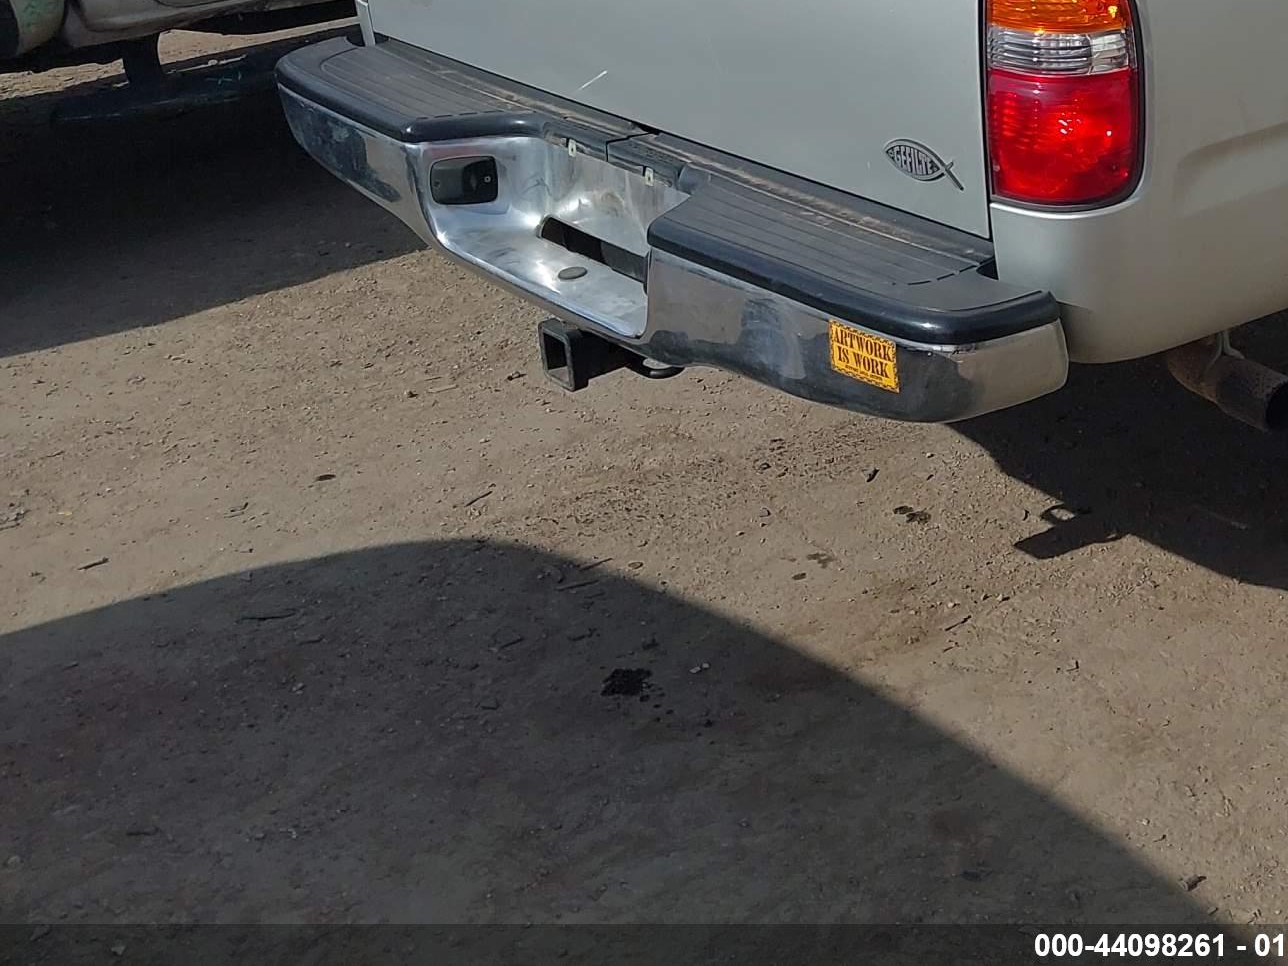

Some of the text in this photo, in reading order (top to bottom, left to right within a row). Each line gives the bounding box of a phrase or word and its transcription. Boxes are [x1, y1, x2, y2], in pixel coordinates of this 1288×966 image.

[893, 146, 934, 175] GEFILTE
[832, 327, 894, 363] ARTWORK
[837, 345, 850, 364] IS
[853, 352, 889, 378] WORK
